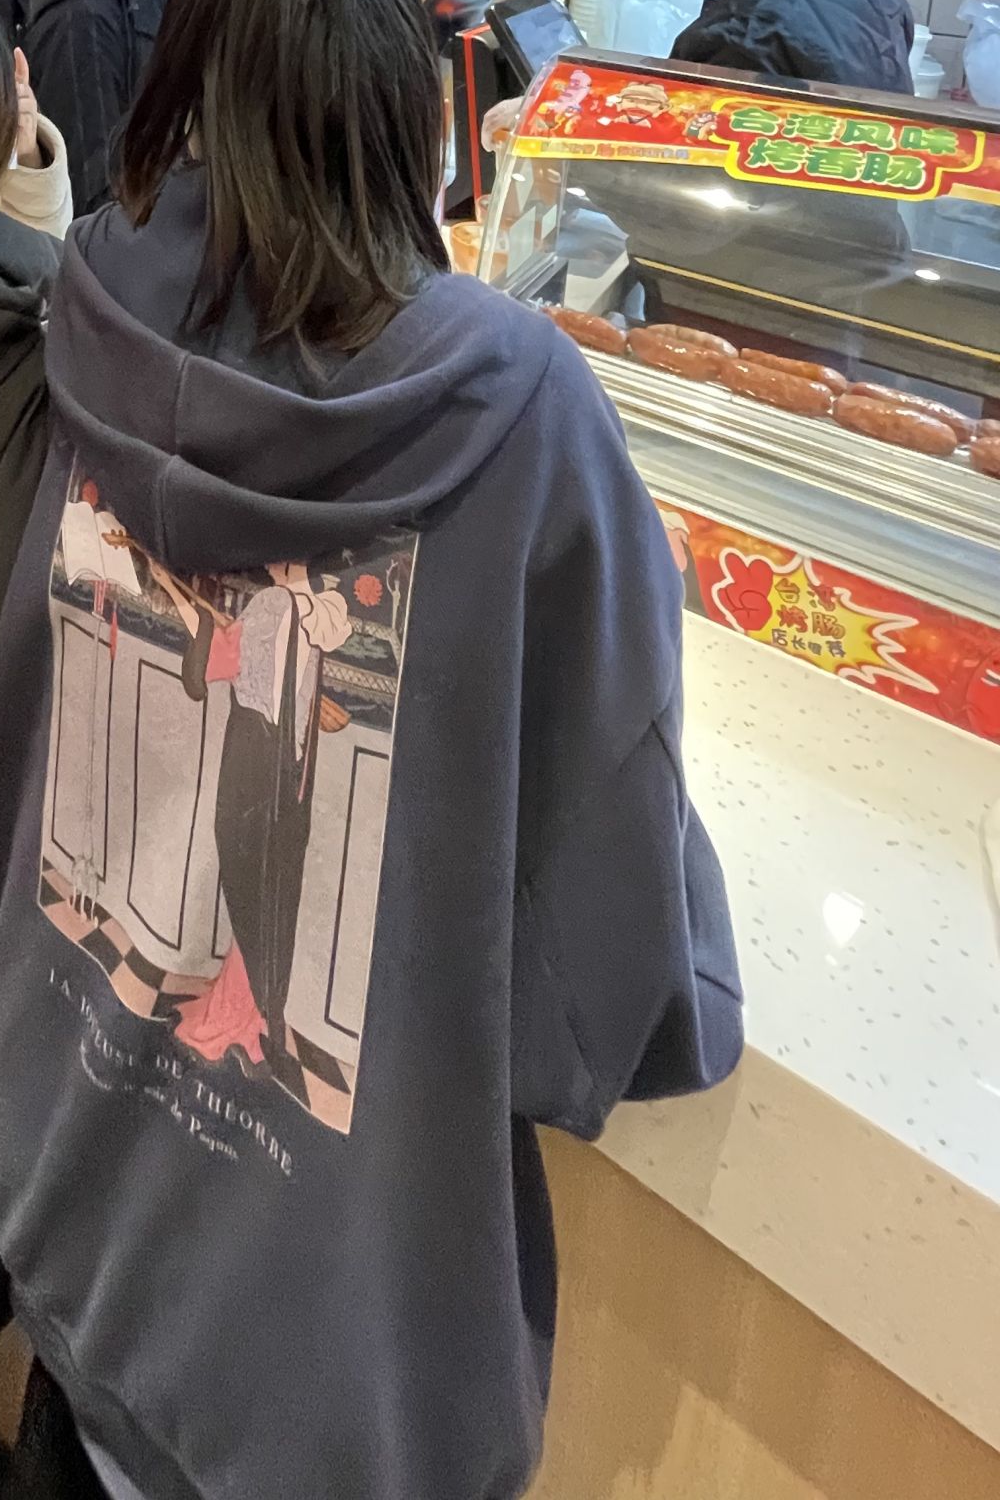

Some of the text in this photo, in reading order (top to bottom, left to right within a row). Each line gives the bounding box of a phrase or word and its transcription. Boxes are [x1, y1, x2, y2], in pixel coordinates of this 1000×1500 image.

[729, 106, 959, 155] 台湾风味
[748, 138, 926, 189] 烤香肠
